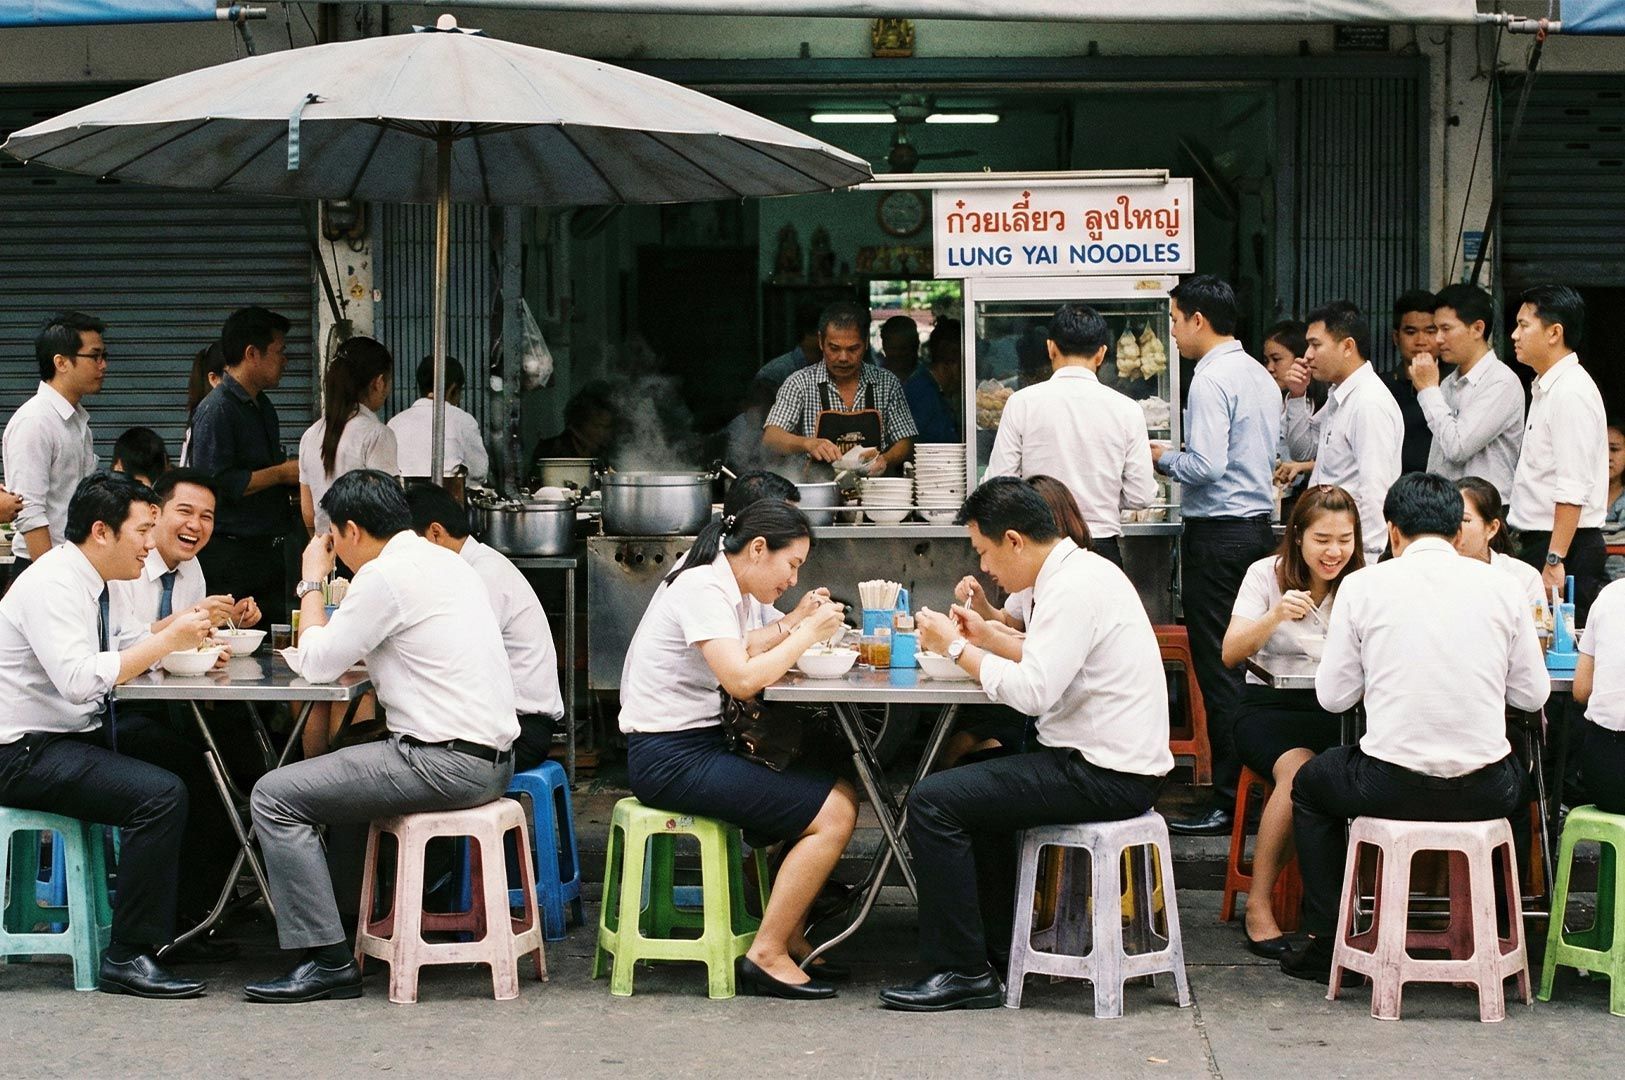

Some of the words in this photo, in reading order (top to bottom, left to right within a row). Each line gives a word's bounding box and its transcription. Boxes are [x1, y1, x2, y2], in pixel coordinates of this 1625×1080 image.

[948, 246, 1013, 267] LUNG
[1022, 245, 1058, 265] YAI
[1070, 243, 1181, 264] NOODLES
